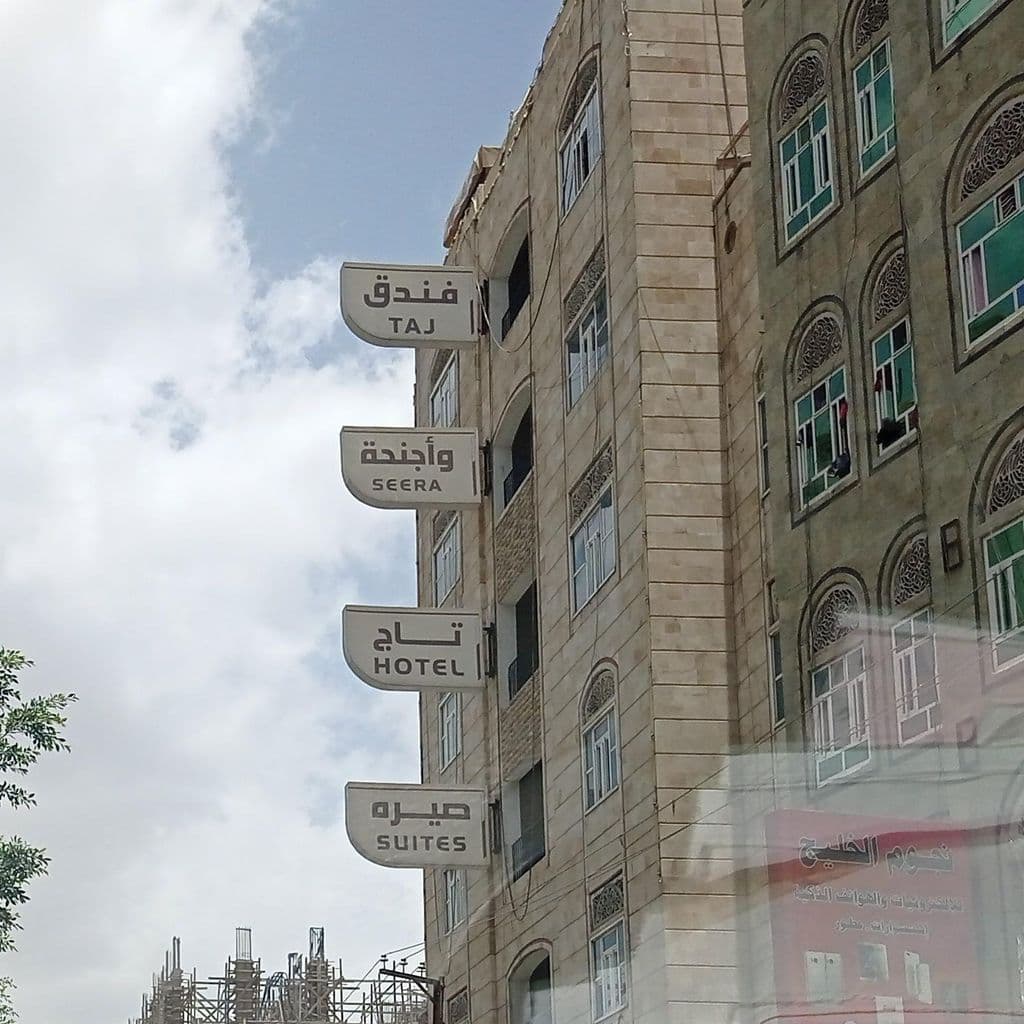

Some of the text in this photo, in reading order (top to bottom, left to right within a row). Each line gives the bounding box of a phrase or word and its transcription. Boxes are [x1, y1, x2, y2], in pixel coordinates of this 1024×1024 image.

[363, 274, 458, 308] فندق
[388, 317, 435, 335] TAJ
[360, 436, 454, 472] وأجنحة
[372, 478, 442, 492] SEERA
[373, 621, 464, 652] تاج
[374, 657, 465, 676] HOTEL
[376, 835, 466, 851] SUITES
[799, 832, 879, 869] الخليج
